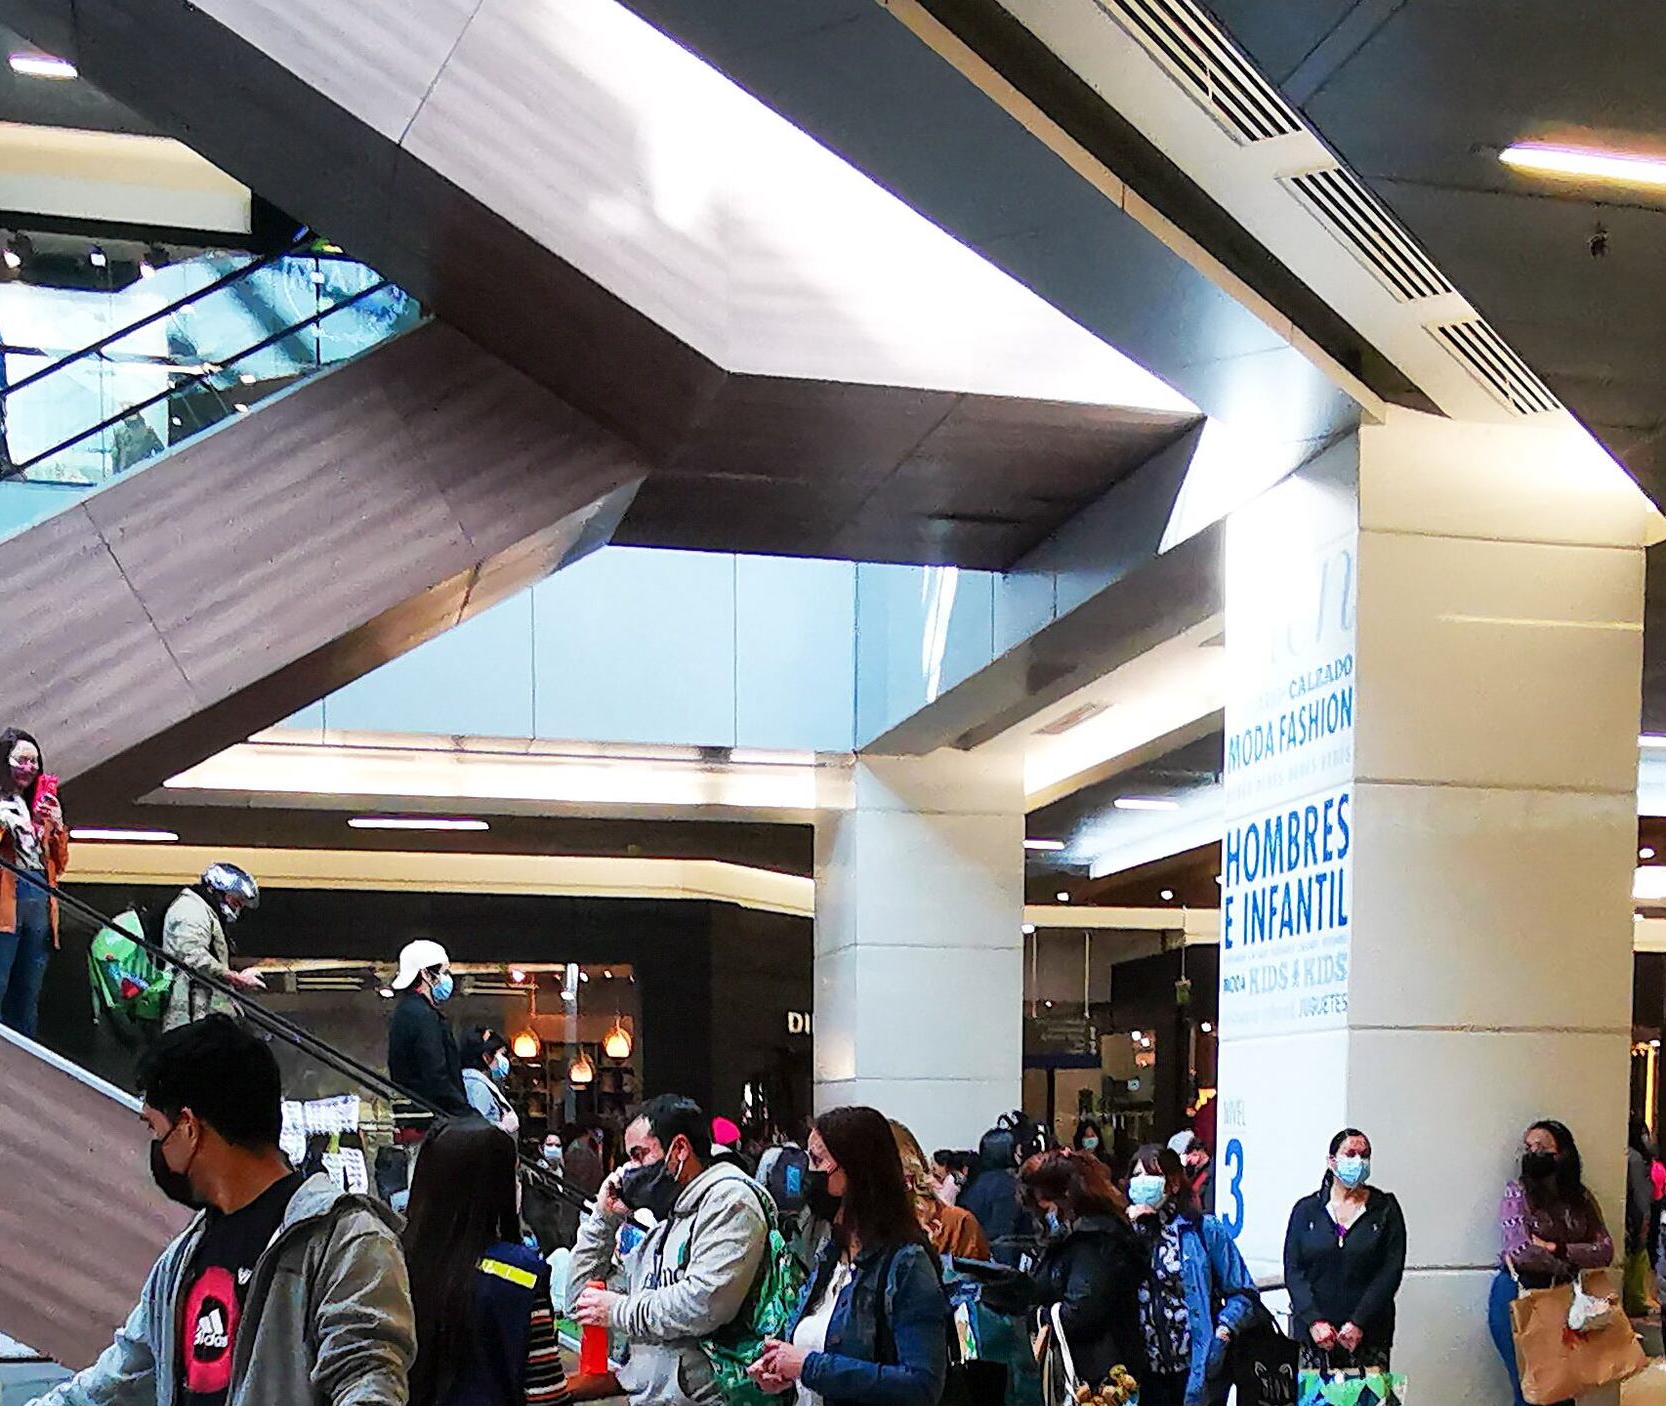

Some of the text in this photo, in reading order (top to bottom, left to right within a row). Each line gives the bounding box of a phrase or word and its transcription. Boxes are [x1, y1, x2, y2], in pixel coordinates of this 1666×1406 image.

[1227, 720, 1275, 774] MODA
[1279, 686, 1353, 753] FASHION
[1226, 793, 1350, 888] HOMBRES
[1225, 895, 1234, 950] E
[1243, 868, 1348, 946] INFANTIL
[1222, 1138, 1244, 1240] 3
